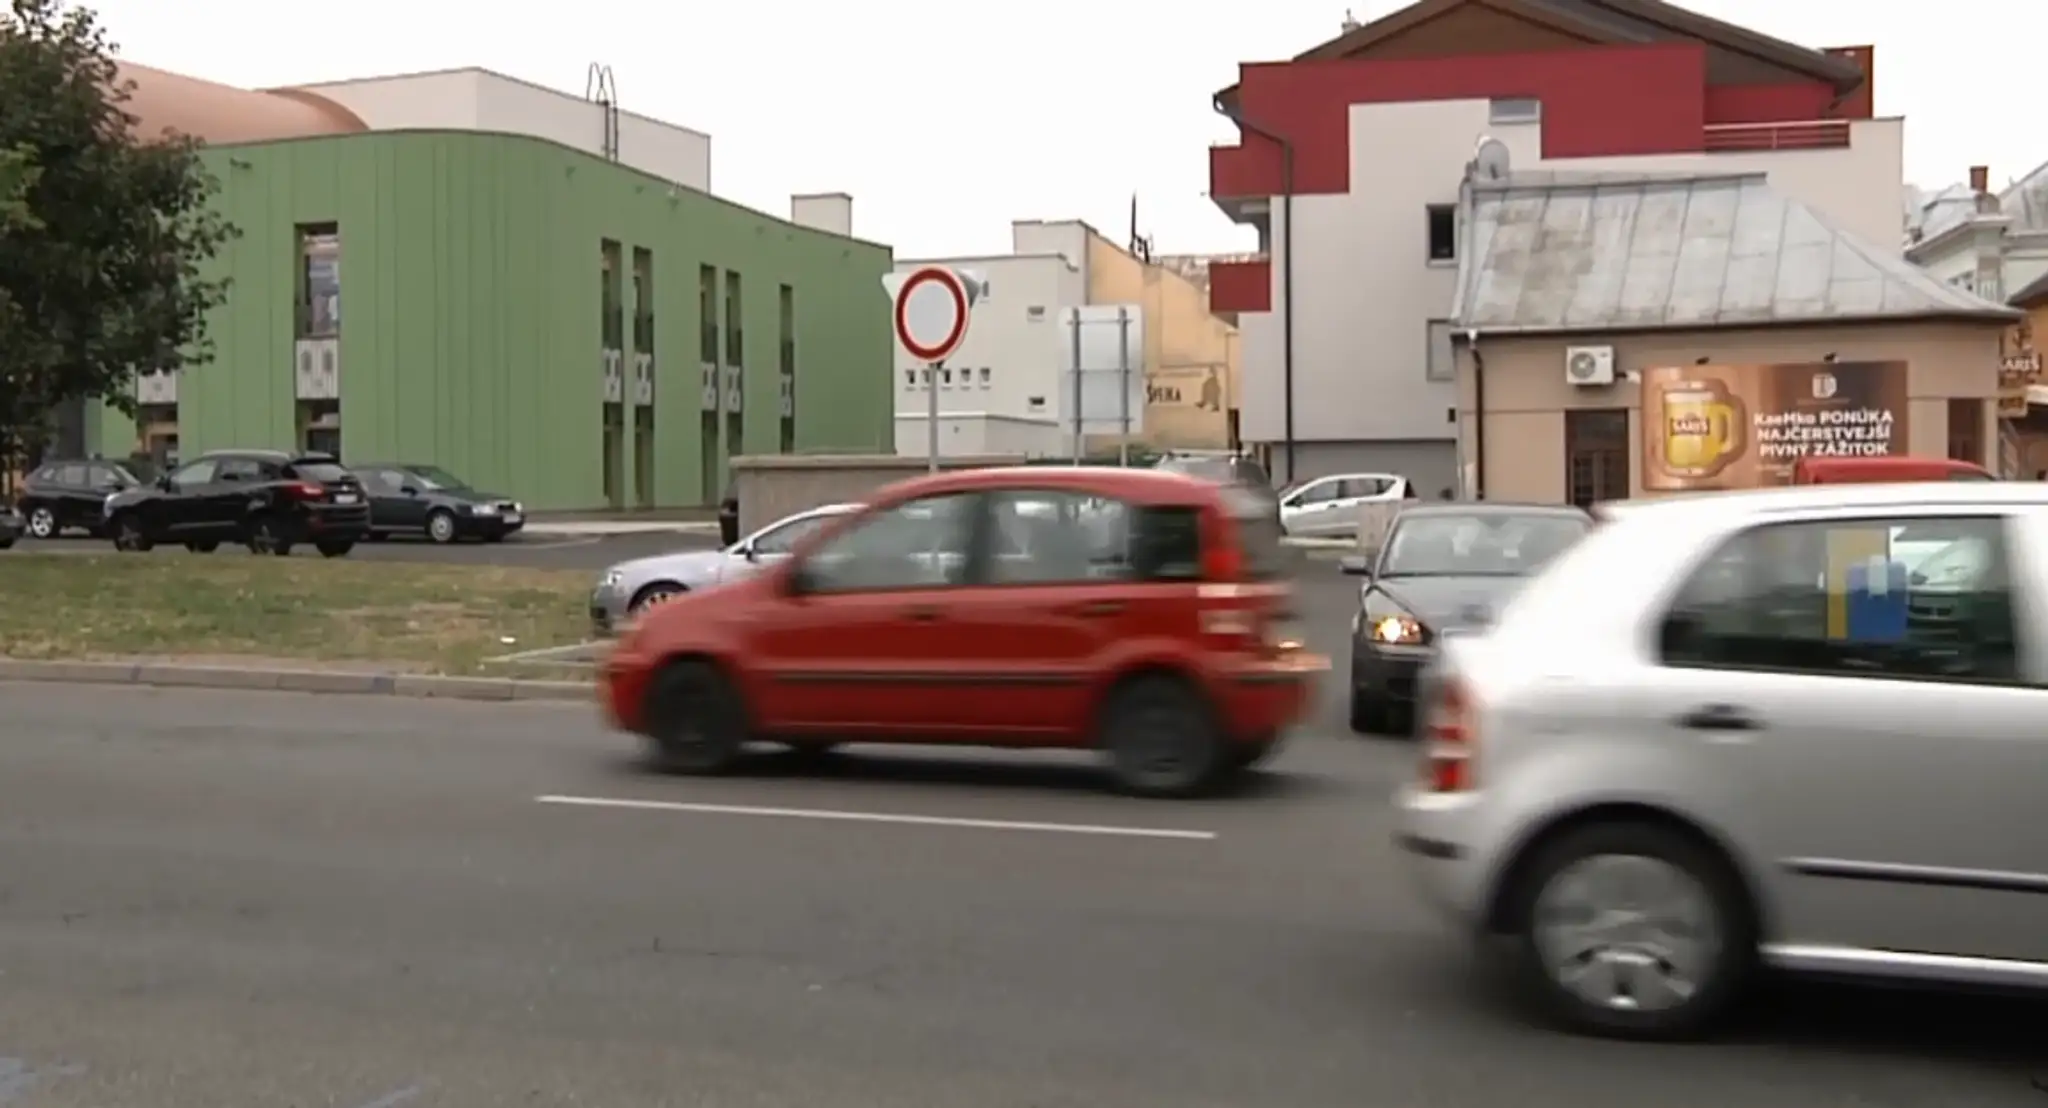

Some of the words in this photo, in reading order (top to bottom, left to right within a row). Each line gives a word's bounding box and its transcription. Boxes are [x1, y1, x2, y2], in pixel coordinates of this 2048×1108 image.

[1819, 407, 1894, 425] PONÚKA
[1756, 421, 1891, 441] NAJČERSTVEJŠÍ
[1813, 440, 1889, 457] ZÁŽITOK
